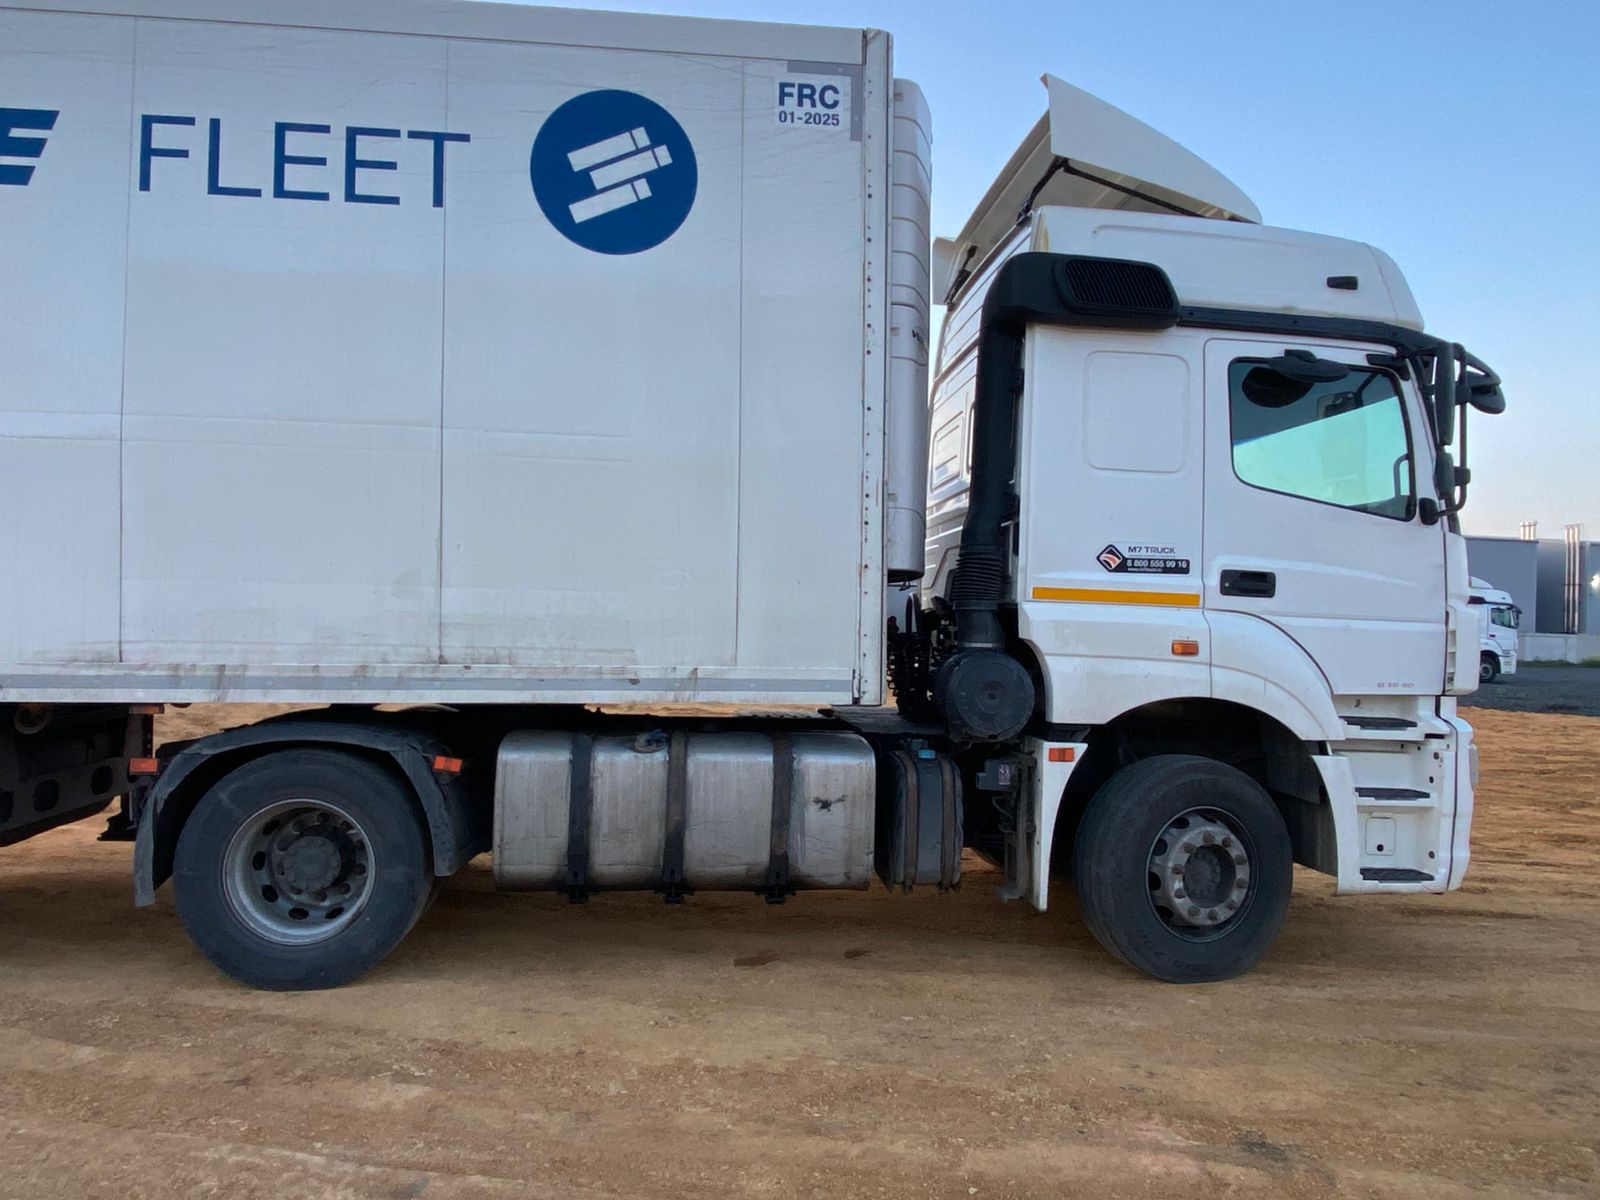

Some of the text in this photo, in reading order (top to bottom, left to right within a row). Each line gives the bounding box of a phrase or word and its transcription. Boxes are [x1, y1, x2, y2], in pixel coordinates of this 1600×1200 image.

[779, 82, 840, 110] FRC
[778, 110, 840, 127] 01-2025
[138, 113, 471, 208] FLEET
[1128, 546, 1176, 554] M7 TRUCK
[1126, 559, 1133, 567] 8
[1133, 559, 1149, 567] 800
